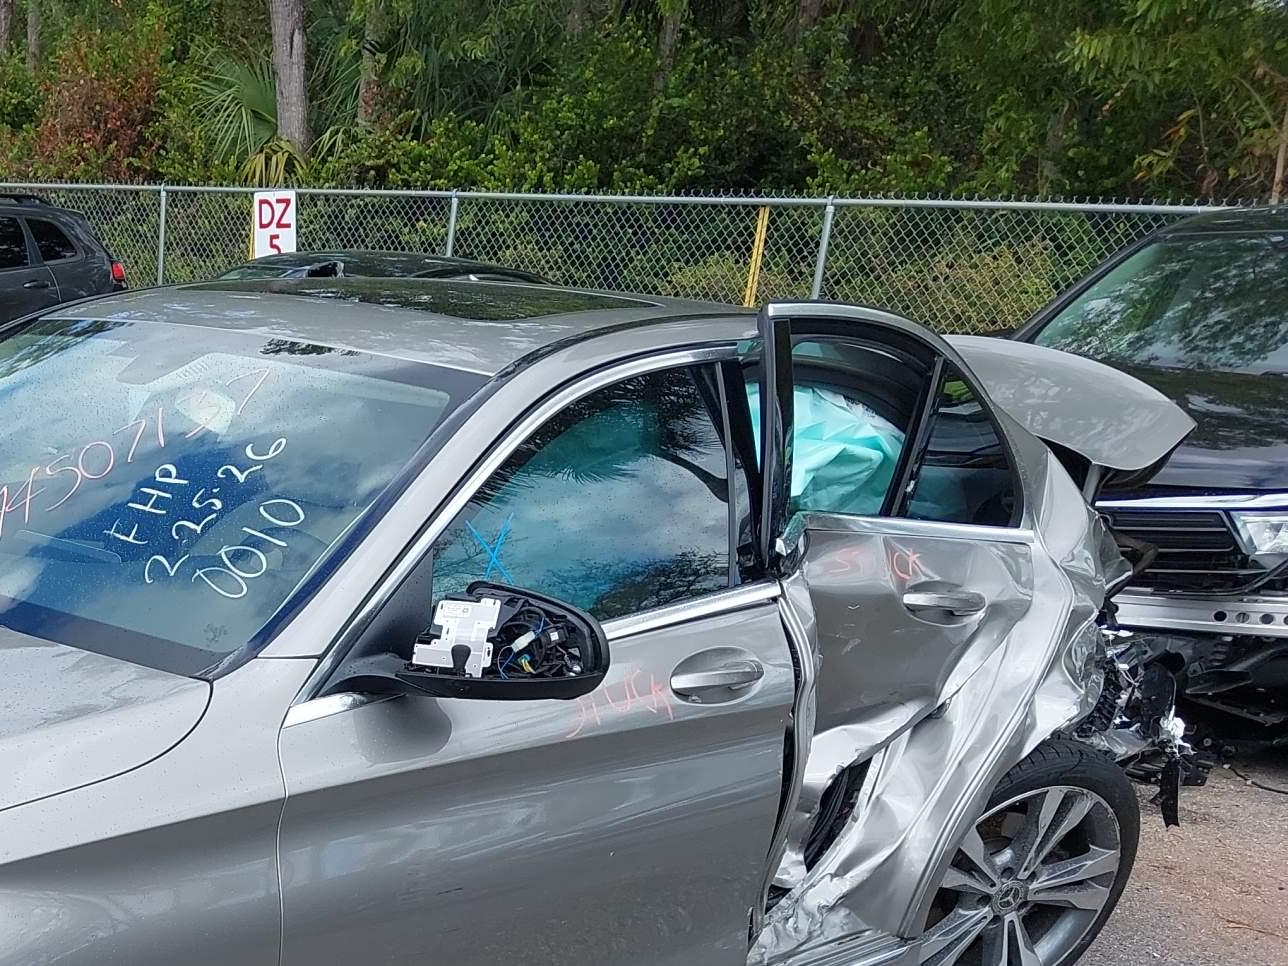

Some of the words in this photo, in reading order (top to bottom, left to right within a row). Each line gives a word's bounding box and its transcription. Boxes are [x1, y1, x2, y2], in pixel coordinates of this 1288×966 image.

[258, 198, 292, 229] DZ
[269, 234, 282, 254] 5
[191, 498, 305, 598] 0010
